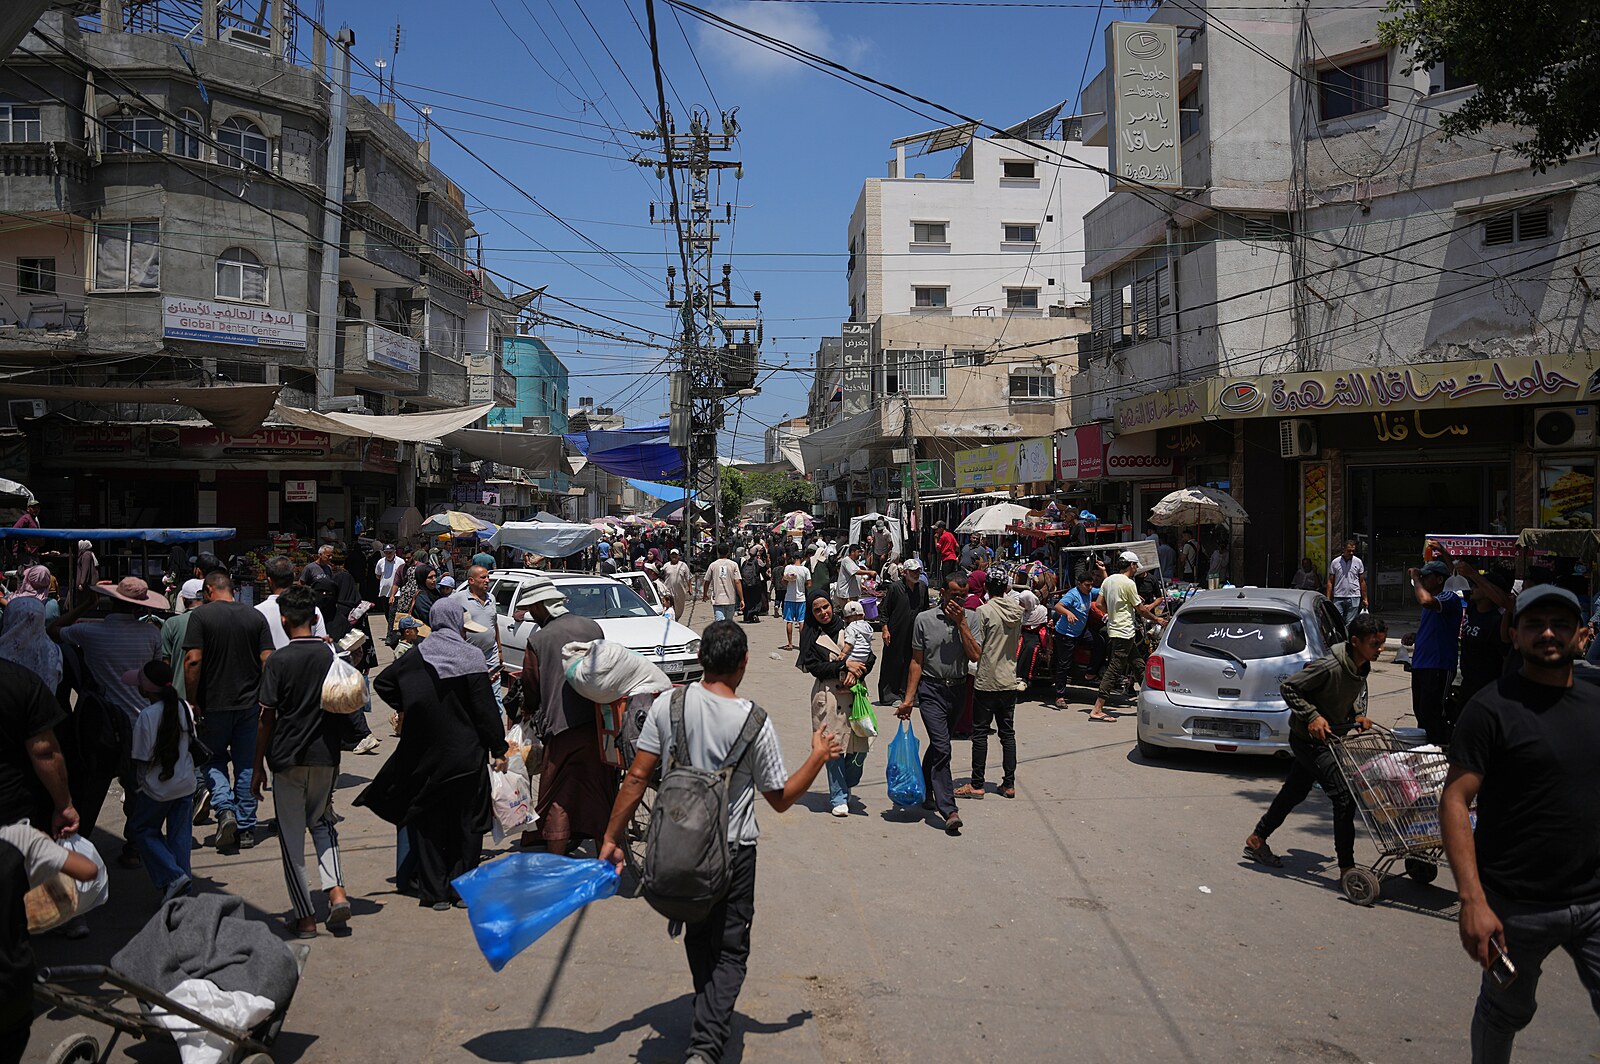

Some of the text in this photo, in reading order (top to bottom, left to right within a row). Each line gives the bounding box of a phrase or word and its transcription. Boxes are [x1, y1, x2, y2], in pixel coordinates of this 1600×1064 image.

[1123, 63, 1169, 81] حلويات
[1128, 102, 1169, 129] ياسر
[1122, 129, 1174, 153] ساقلا
[1124, 163, 1172, 181] الشهيرة
[167, 302, 294, 325] المركز العالمي للأسنان
[180, 318, 215, 330] Global
[219, 322, 249, 334] Dental
[251, 325, 281, 337] Center
[845, 339, 868, 348] معرض
[844, 349, 869, 366] أبو
[1270, 358, 1581, 412] حلويات ساقلا الشهيرة
[1144, 398, 1168, 424] ساقلا
[1165, 391, 1201, 419] حلويات
[1373, 409, 1470, 442] ساقلا
[1166, 424, 1201, 453] حلويات
[1109, 455, 1171, 468] ooredoo
